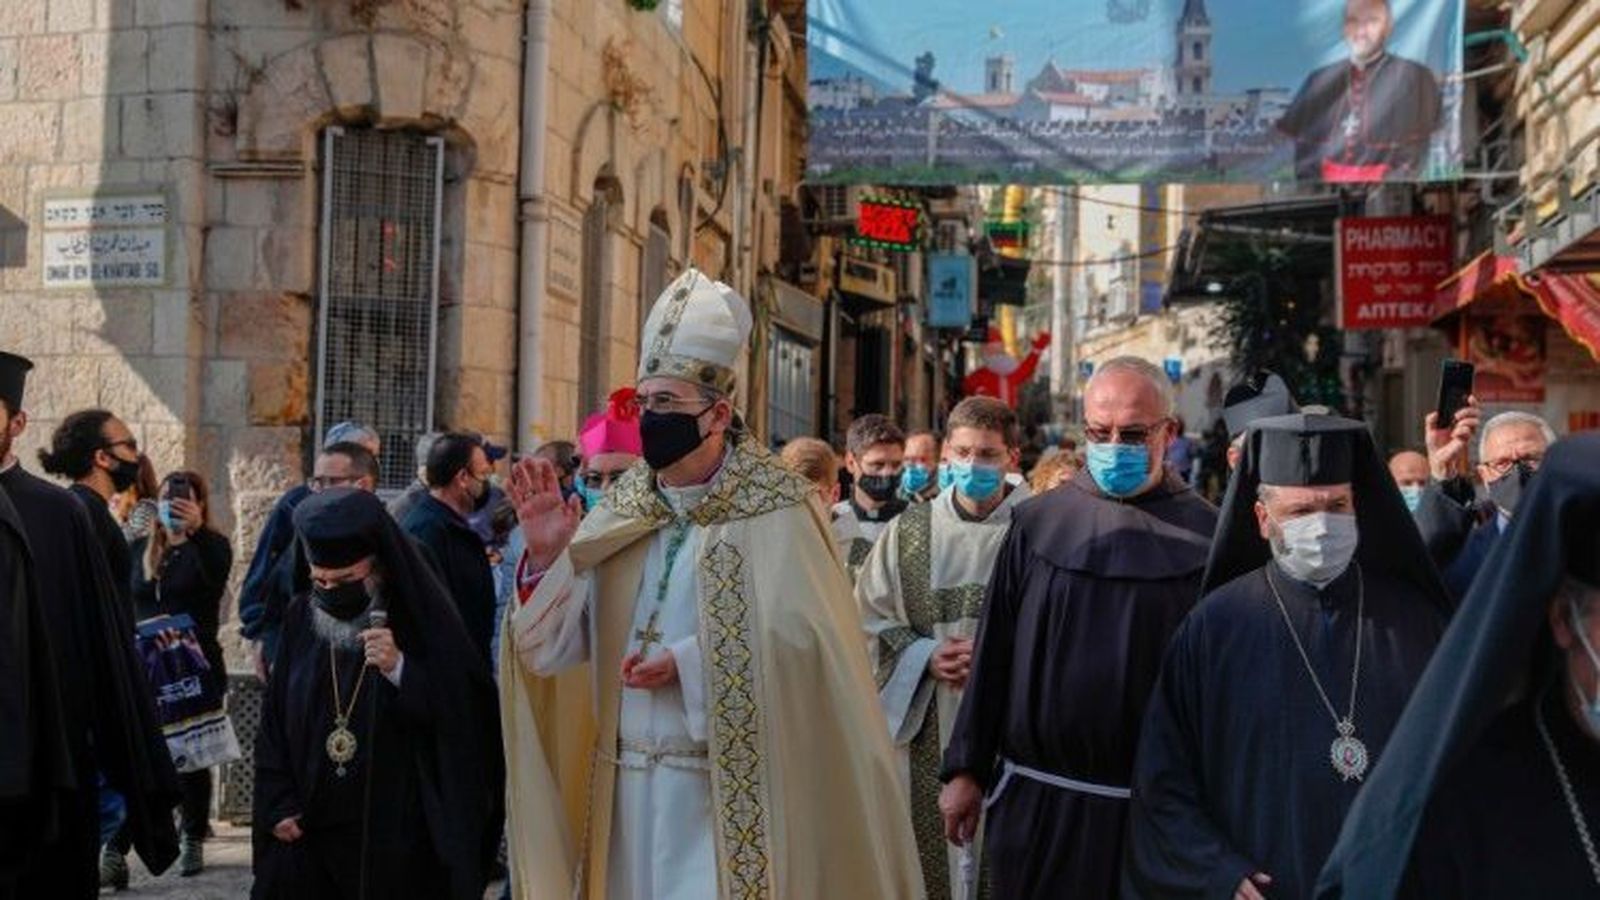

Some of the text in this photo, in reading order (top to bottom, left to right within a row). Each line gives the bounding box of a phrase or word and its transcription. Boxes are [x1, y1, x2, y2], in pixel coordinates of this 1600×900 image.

[1346, 224, 1447, 251] PHARMACY
[1347, 261, 1448, 280] בית מרקחת
